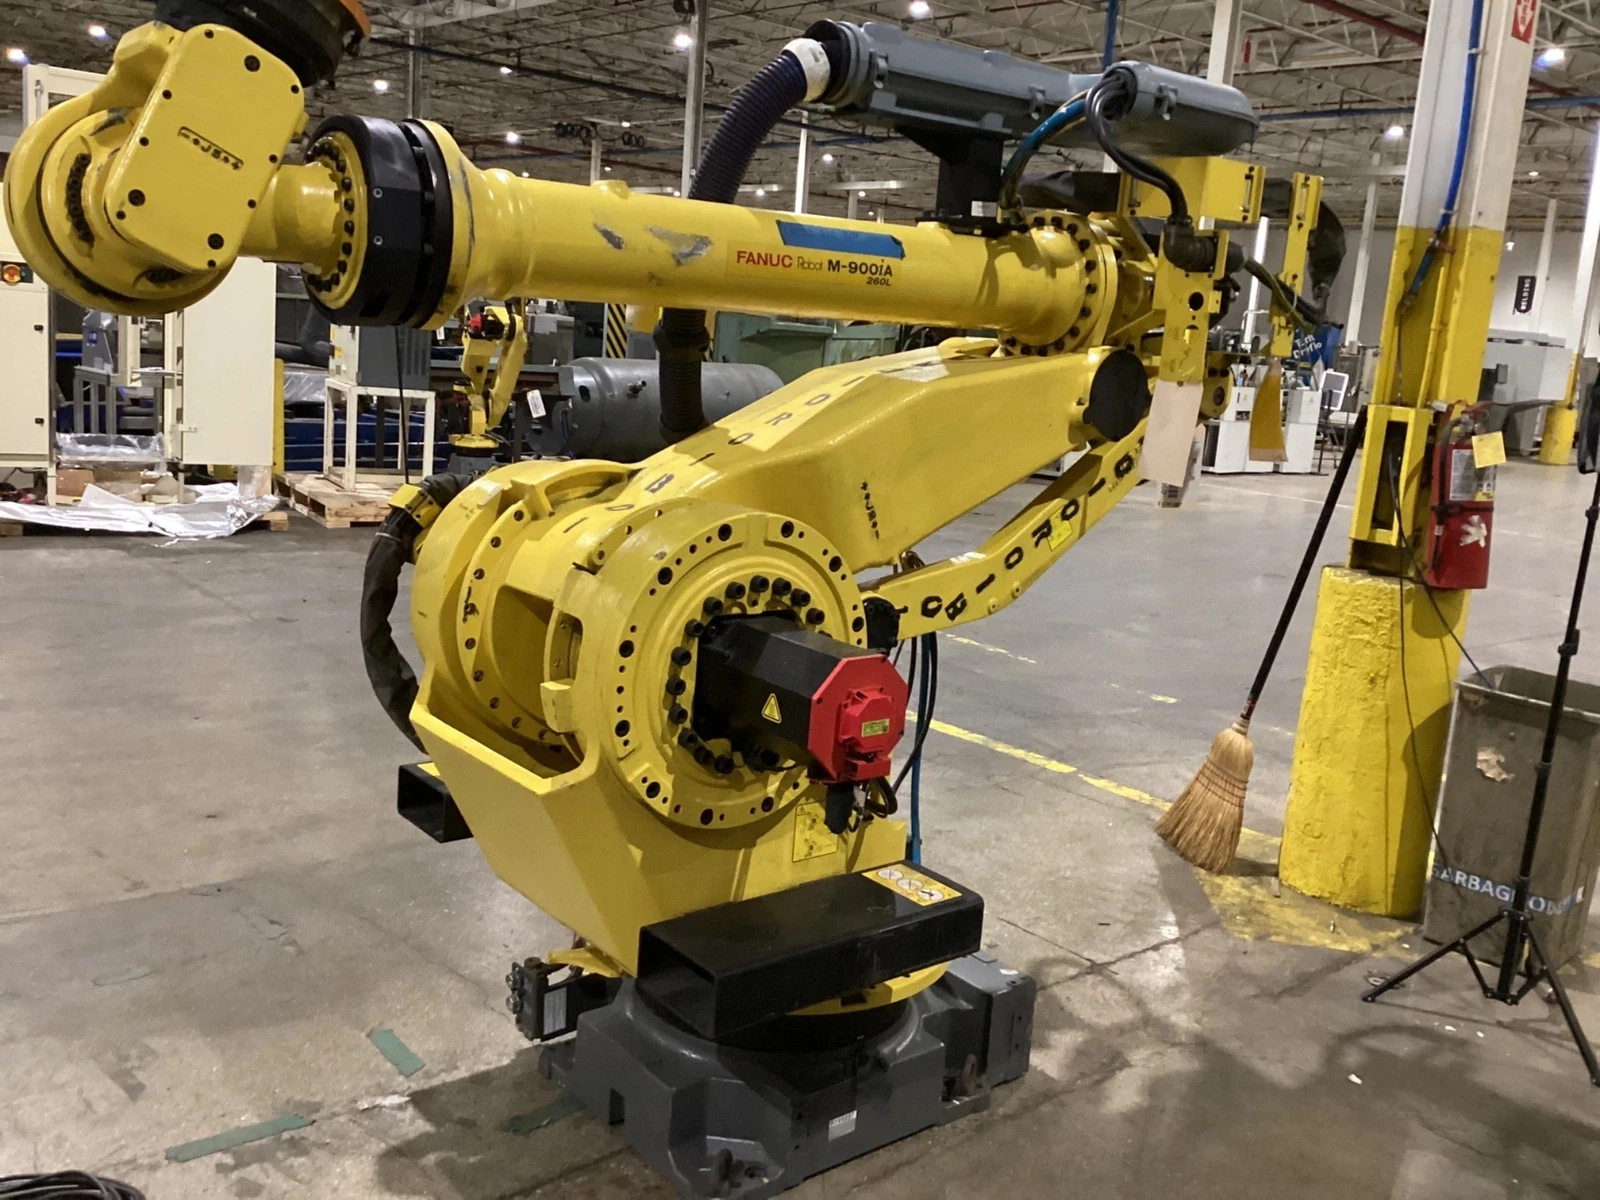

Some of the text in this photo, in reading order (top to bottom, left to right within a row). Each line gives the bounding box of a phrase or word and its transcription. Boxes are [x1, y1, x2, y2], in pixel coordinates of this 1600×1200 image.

[736, 250, 893, 277] FANUC Robot M-900iA
[866, 276, 892, 287] 260L
